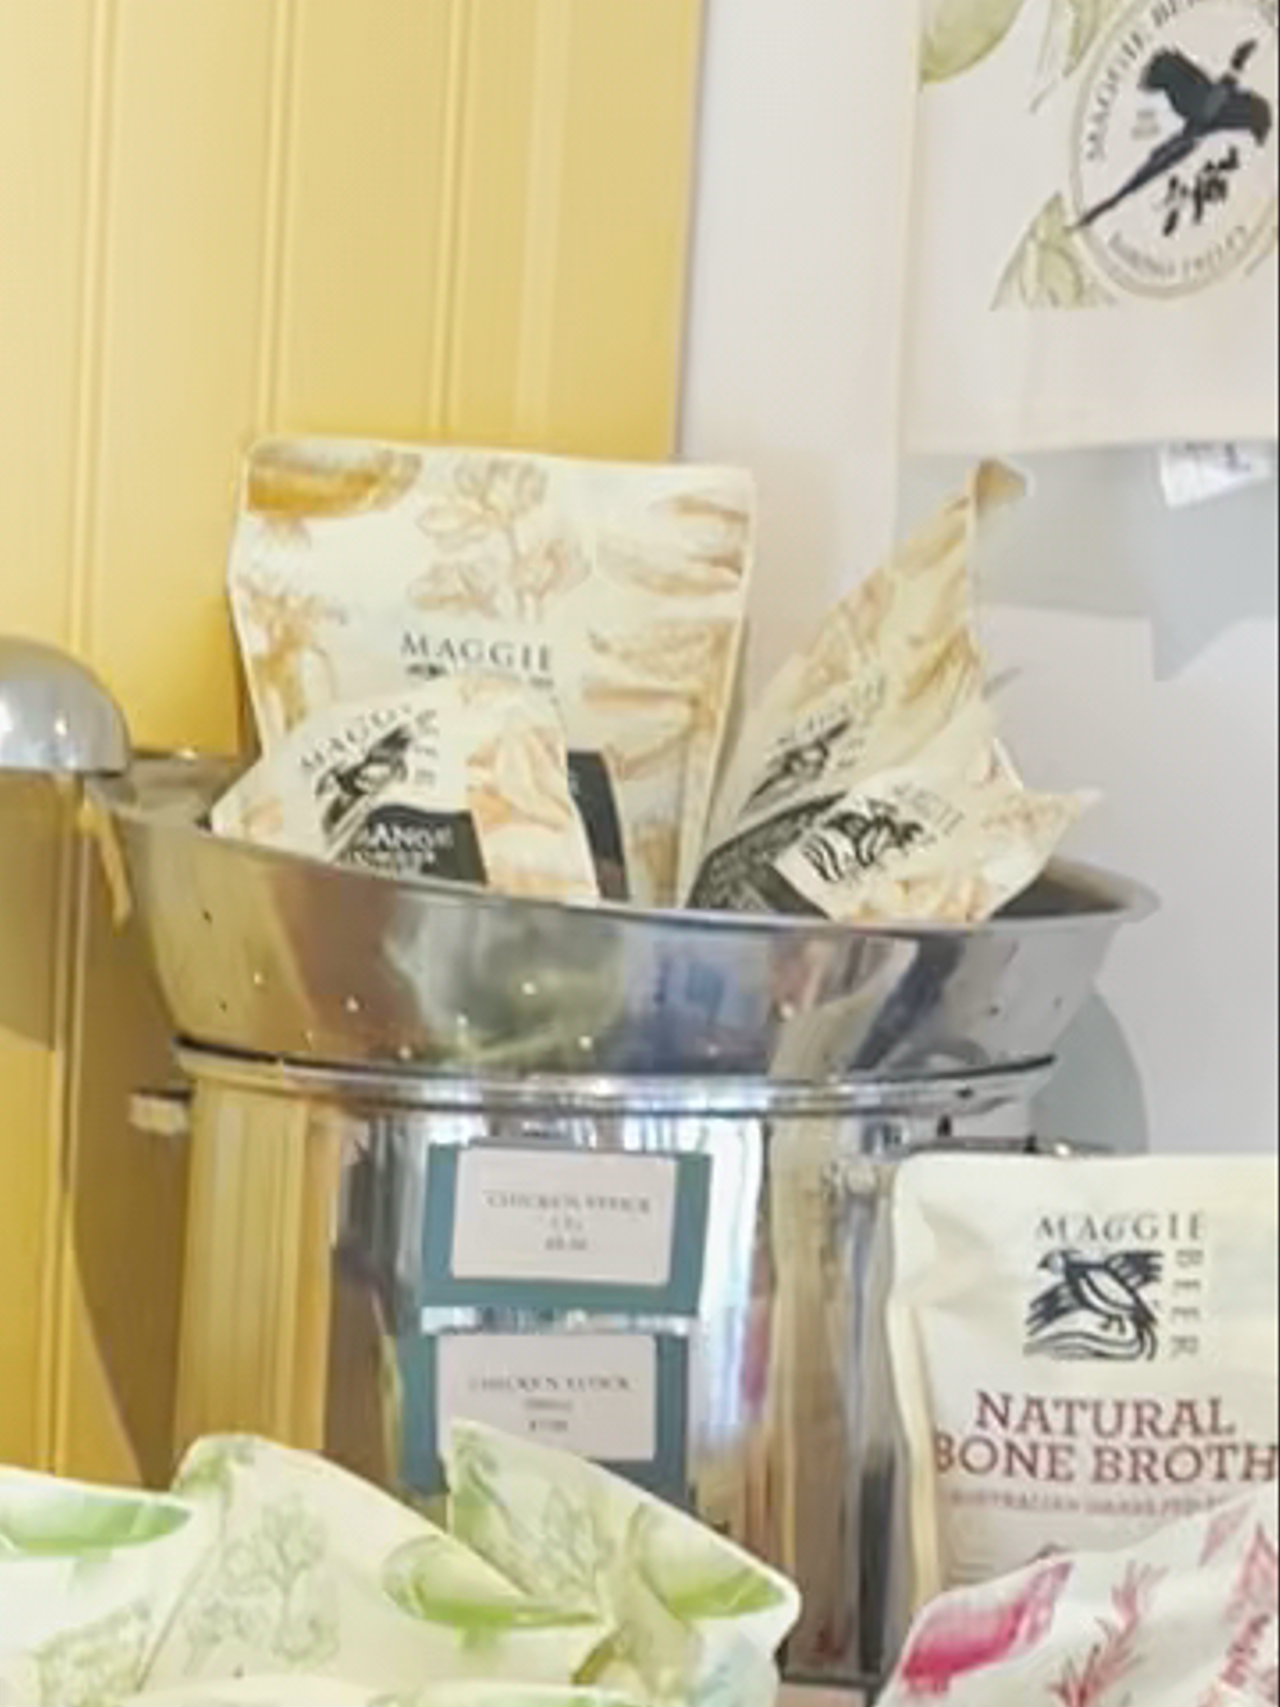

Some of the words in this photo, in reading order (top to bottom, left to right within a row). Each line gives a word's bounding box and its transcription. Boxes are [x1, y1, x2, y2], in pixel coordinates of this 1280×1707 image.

[401, 631, 555, 672] MAGGIE
[1037, 1212, 1203, 1242] MAGGIE
[1170, 1249, 1204, 1359] BEER
[975, 1391, 1236, 1438] NATURAL
[933, 1430, 1077, 1482] BONE
[1092, 1443, 1278, 1485] BROTH
